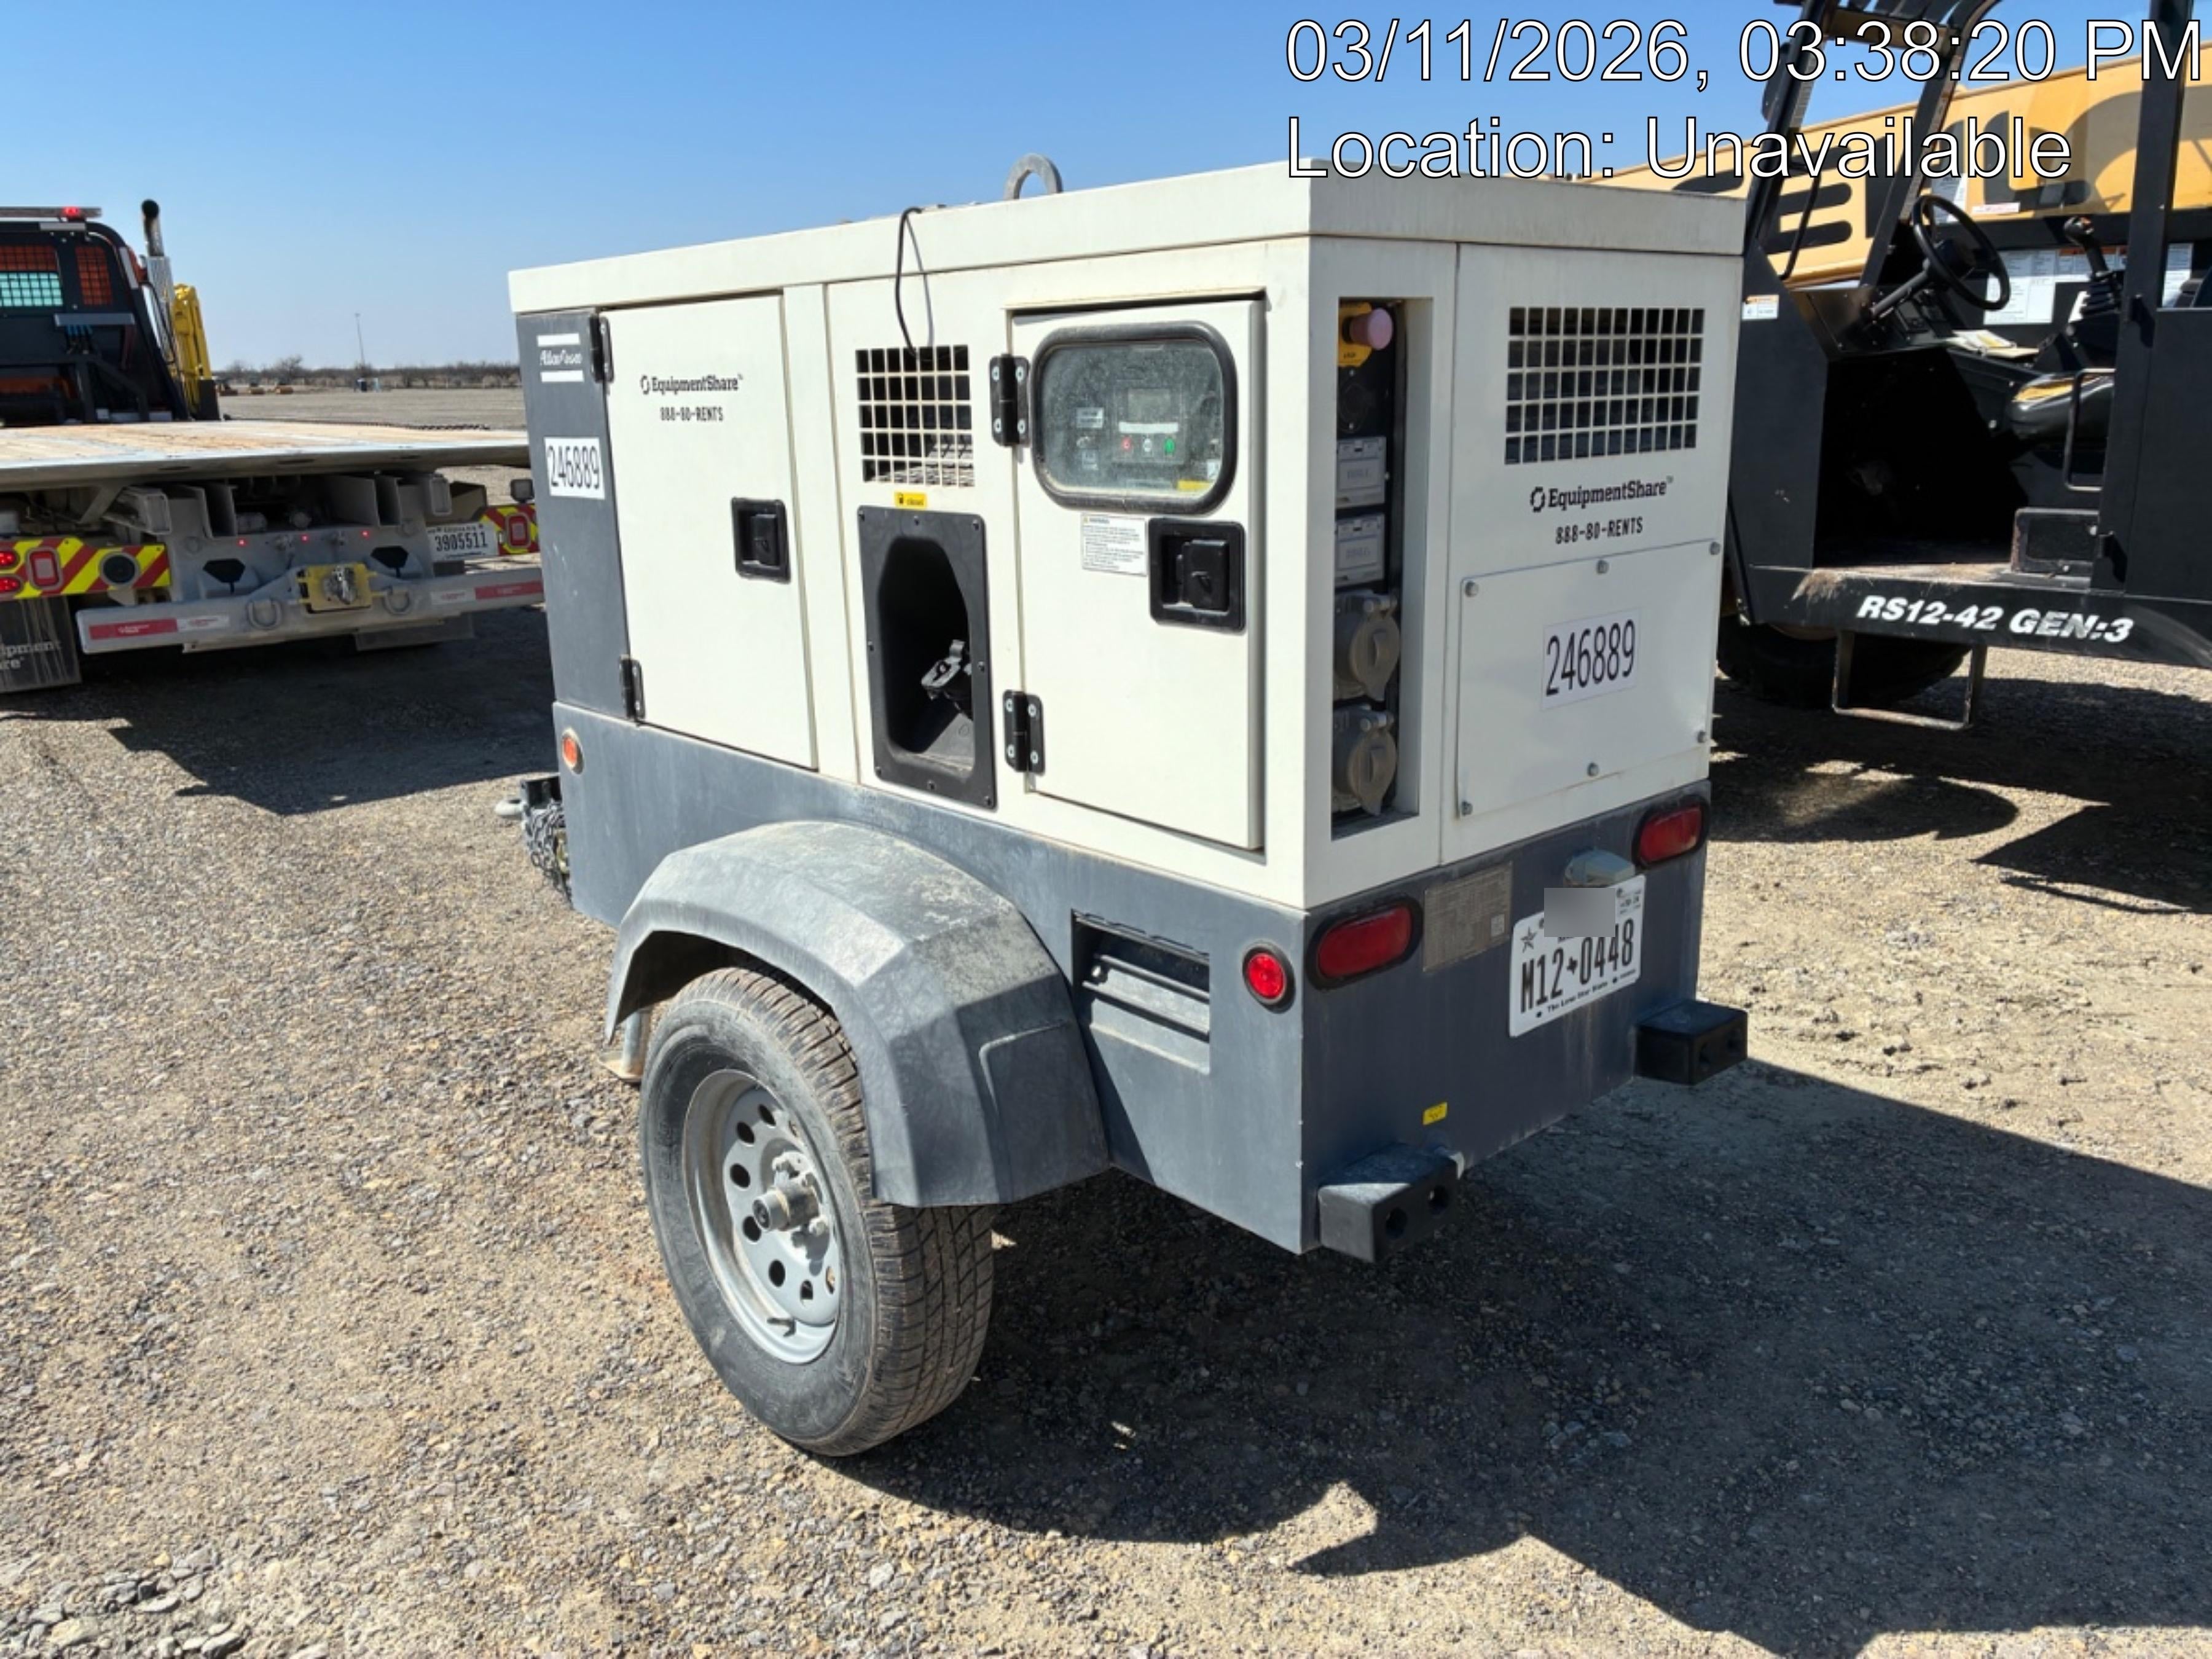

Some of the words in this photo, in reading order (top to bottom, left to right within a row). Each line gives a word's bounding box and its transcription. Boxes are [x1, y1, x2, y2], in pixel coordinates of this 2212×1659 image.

[652, 374, 739, 395] EquipmentShare
[546, 445, 600, 490] 246889
[1547, 479, 1668, 511] EquipmentShare
[1555, 516, 1644, 544] 888-80-RENTS
[1856, 595, 2004, 631] RS12-42
[2008, 608, 2135, 643] GEN:3
[1545, 619, 1636, 697] 246889
[1580, 918, 1634, 986] 0448
